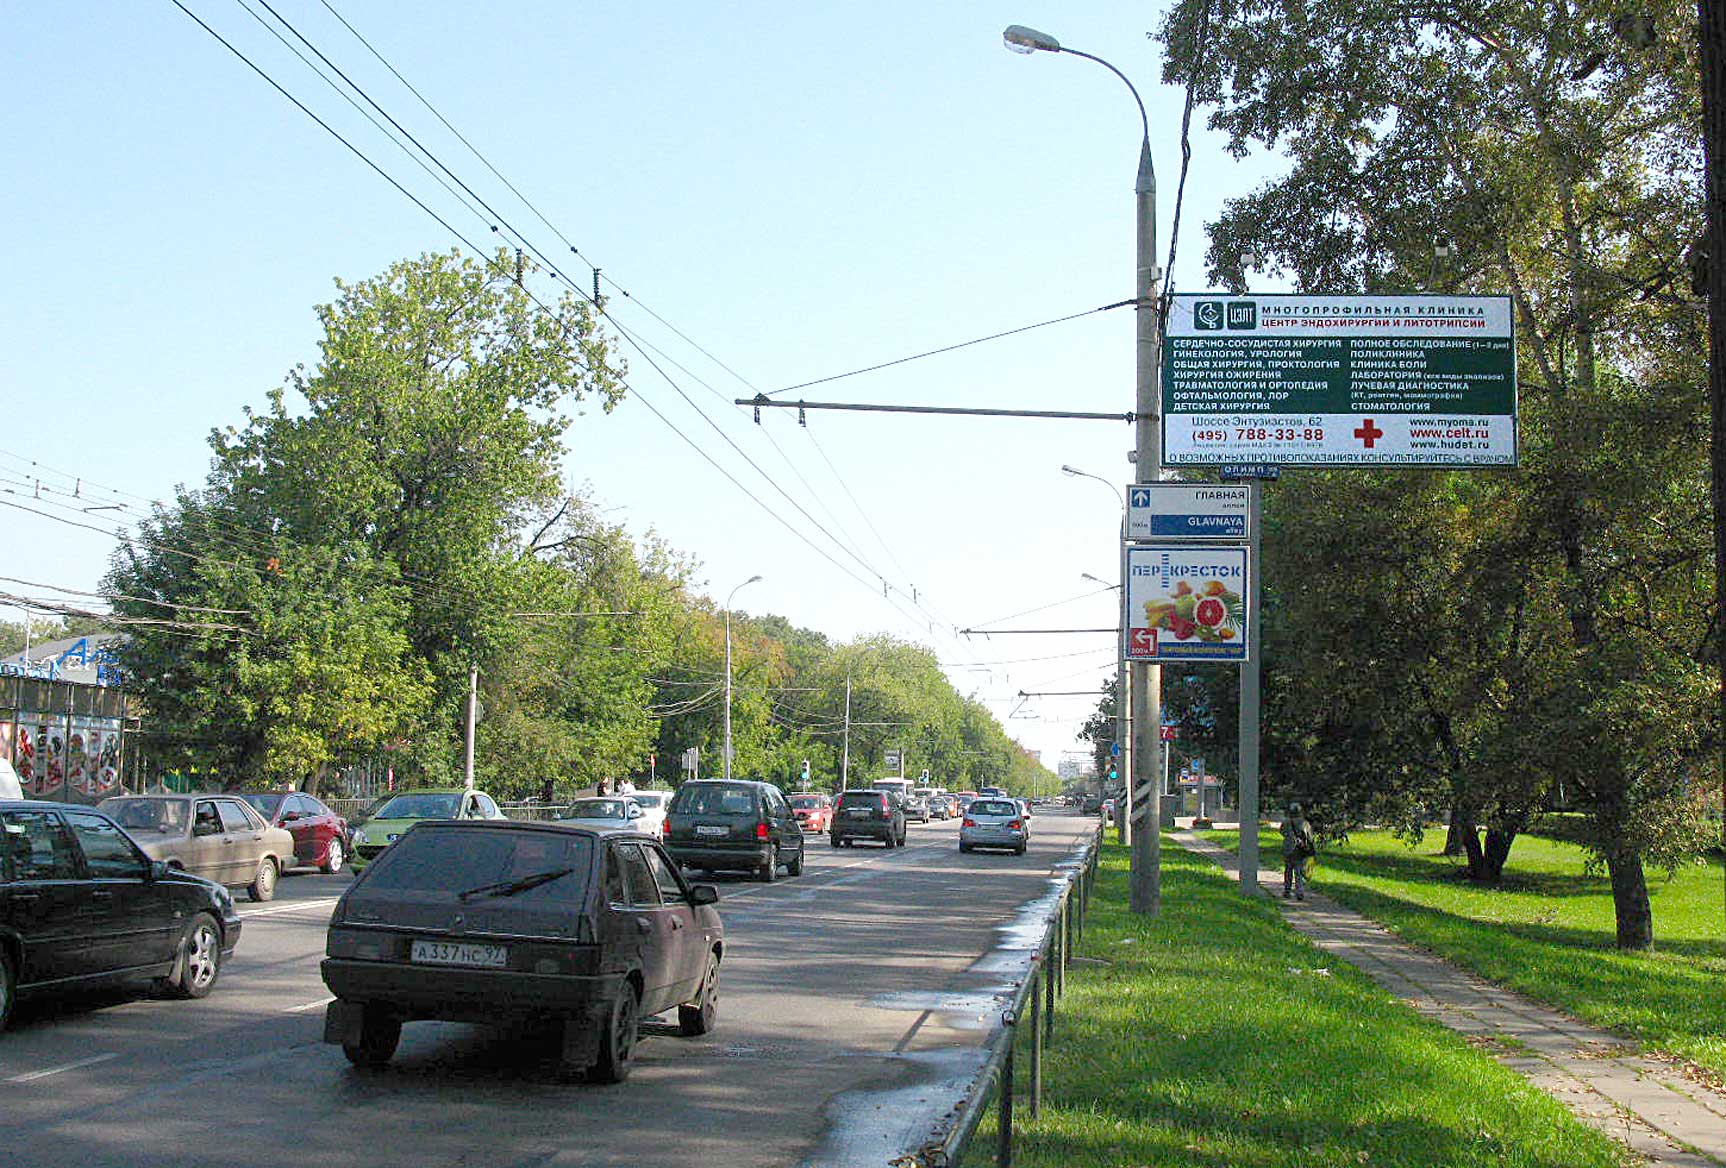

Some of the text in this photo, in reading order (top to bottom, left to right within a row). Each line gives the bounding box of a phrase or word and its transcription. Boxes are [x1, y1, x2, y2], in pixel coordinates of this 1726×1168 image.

[1262, 306, 1484, 315] МНОГОПРОФИЛЬНАЯ КЛИНИКА
[1262, 320, 1486, 328] ЦЕНТР ЭНДОХИРУРГИИ И ЛИТОТРИПСИИ
[1173, 340, 1342, 349] СЕРДЕЧНО-СОСУДИСТАЯ ХИРУРГИЯ
[1350, 340, 1391, 348] ПОЛНОЕ
[1392, 340, 1472, 350] ОБСЛЕДОВАНИЕ
[1173, 350, 1302, 359] ГИНЕКОЛОГИЯ, УРОЛОГИЯ
[1350, 350, 1426, 358] ПОЛИКЛИНИКА
[1173, 361, 1340, 370] ОБЩАЯ ХИРУРГИЯ, ПРОКТОЛОГИЯ
[1350, 361, 1427, 369] КЛИНИКА БОЛИ
[1350, 372, 1422, 380] ЛАБОРАТОРИЯ
[1173, 382, 1328, 390] ТРАВМАТОЛОГИЯ И ОРТОПЕДИЯ
[1350, 382, 1469, 391] ЛУЧЕВАЯ ДИАГНОСТИКА
[1173, 392, 1289, 400] ОФТАЛЬМОЛОГИЯ, ЛОР
[1173, 402, 1218, 412] ДЕТСКАЯ
[1350, 402, 1430, 410] СТОМАТОЛОГИЯ
[1192, 417, 1230, 426] Шоссе
[1308, 417, 1322, 426] 62
[1410, 418, 1489, 428] www.myoma.ru
[1192, 428, 1324, 442] (495) 788-33-88
[1410, 428, 1489, 438] www.celt.ru
[1410, 440, 1490, 450] www.hudet.ru
[1169, 453, 1513, 463] О ВОЗМОЖНЫХ ПРОТИВОПОКАЗАНИЯХ КОНСУЛЬТИРУЙТЕСЬ С ВРАЧОМ
[1195, 491, 1245, 500] ГЛАВНАЯ
[1188, 516, 1244, 526] GLAVNAYA
